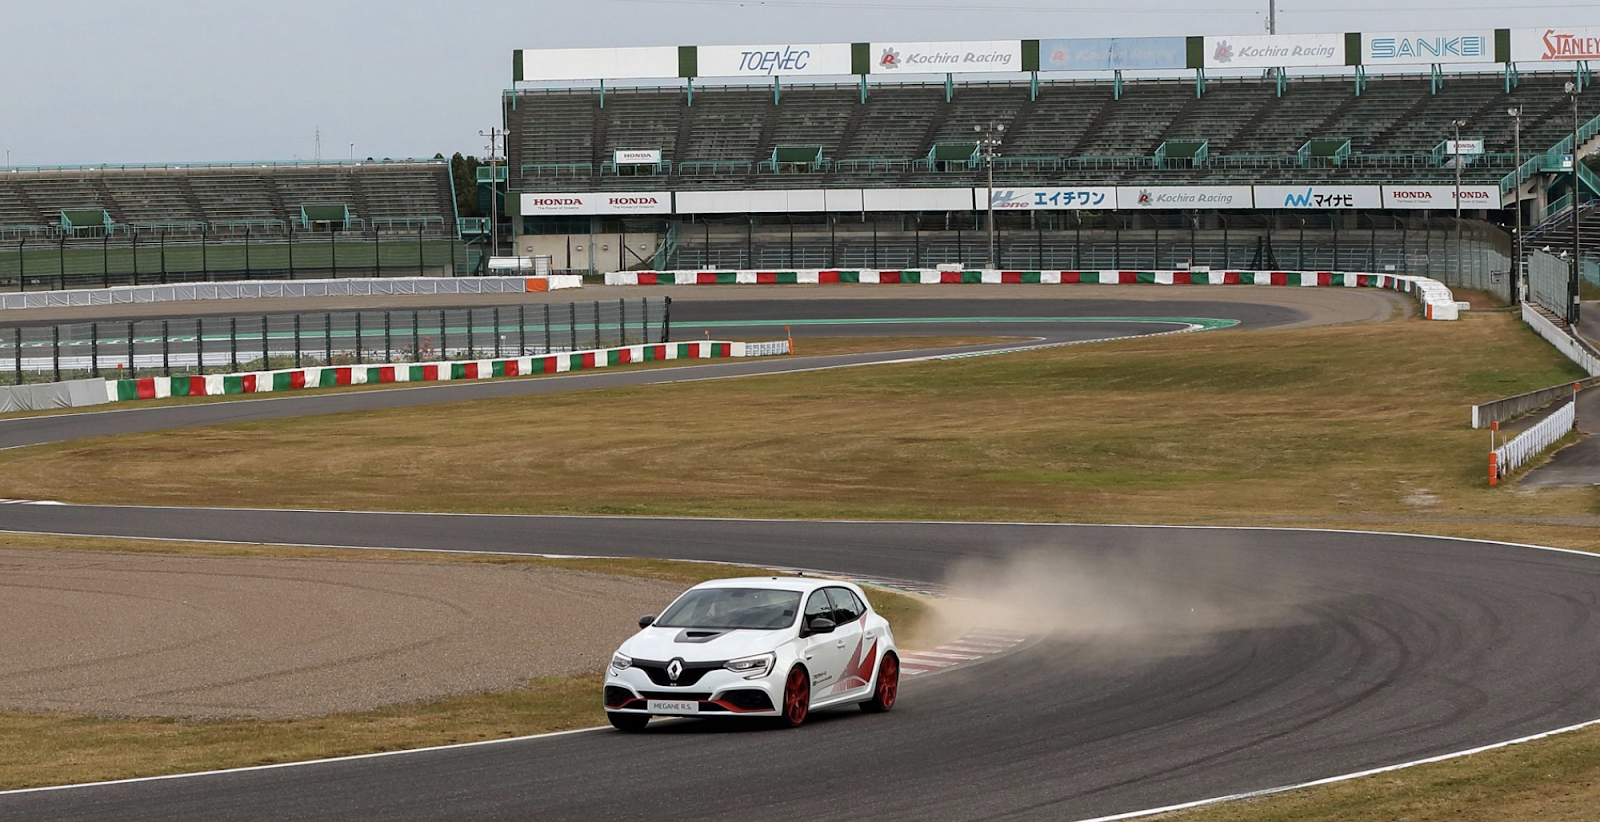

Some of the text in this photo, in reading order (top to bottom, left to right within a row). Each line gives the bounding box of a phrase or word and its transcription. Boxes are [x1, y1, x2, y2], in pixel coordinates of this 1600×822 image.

[1371, 36, 1485, 58] SANKEI
[1541, 29, 1600, 60] STANLEY
[1238, 46, 1288, 57] Kochira
[1292, 45, 1335, 58] Racing
[739, 45, 810, 75] TOENEC
[905, 53, 959, 64] Kochira
[963, 52, 1012, 65] Racing
[1034, 191, 1105, 206] エイチワン
[1156, 194, 1195, 202] Kochira
[1197, 193, 1233, 204] Racing
[1313, 194, 1353, 207] マイナビ
[1393, 191, 1433, 199] HONDA
[1451, 191, 1490, 199] HONDA
